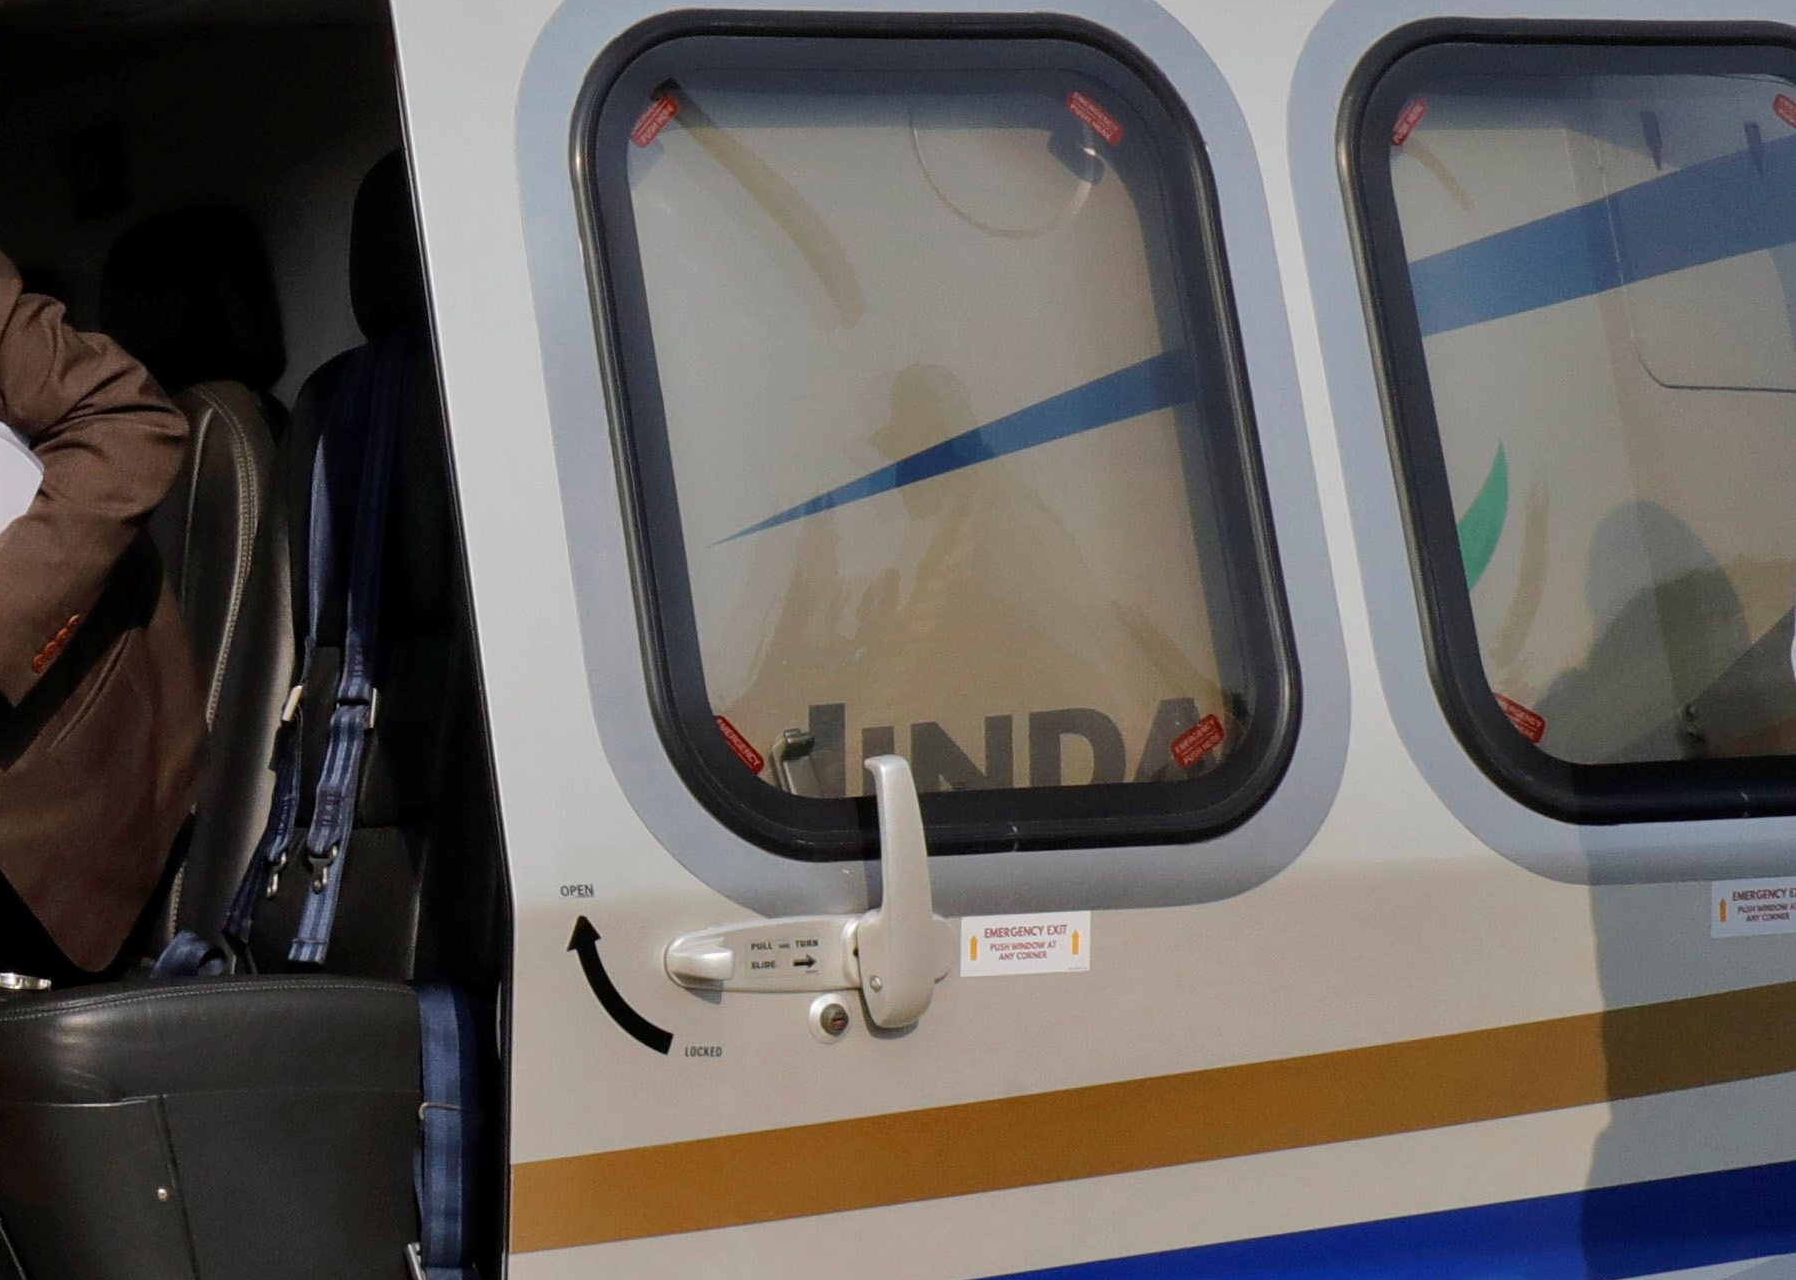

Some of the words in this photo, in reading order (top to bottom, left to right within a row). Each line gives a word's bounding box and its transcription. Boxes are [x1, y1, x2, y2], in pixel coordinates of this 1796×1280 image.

[560, 883, 595, 899] OPEN
[1732, 888, 1787, 901] EMERGENCY
[984, 925, 1045, 939] EMERGENCY
[1047, 924, 1068, 936] EXIT
[990, 942, 1010, 952] PUSH
[1011, 941, 1046, 951] WINDOW
[1047, 940, 1057, 949] AT
[998, 952, 1014, 961] ANY
[1016, 951, 1047, 960] CORNER
[684, 1045, 723, 1059] LOCKED
